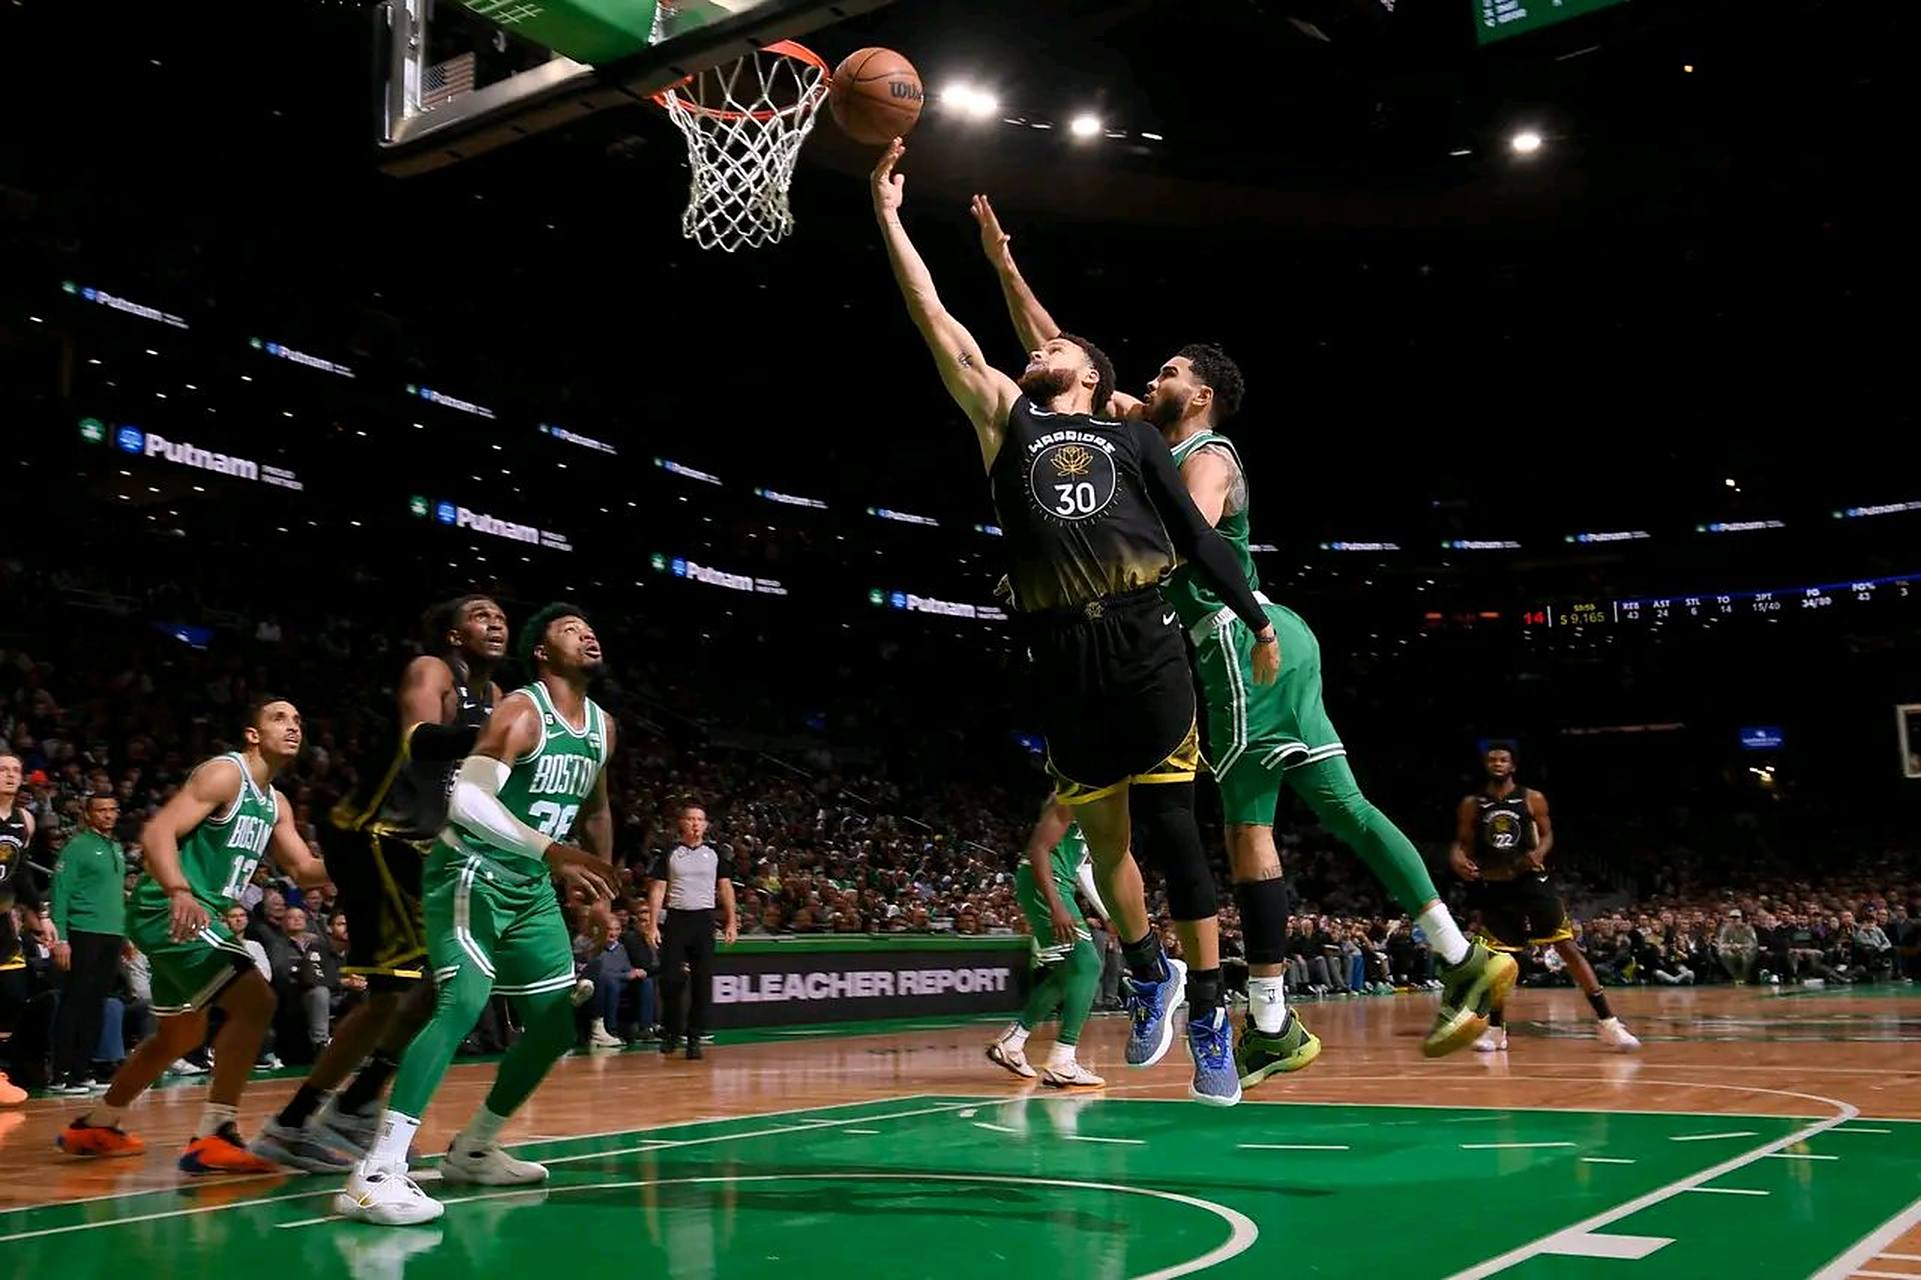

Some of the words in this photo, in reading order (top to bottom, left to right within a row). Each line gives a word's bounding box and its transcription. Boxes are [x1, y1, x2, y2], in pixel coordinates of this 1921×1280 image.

[144, 432, 259, 481] Putnam
[1028, 430, 1116, 454] WARRIORS
[1054, 482, 1097, 515] 30
[456, 506, 539, 545] Putnam
[1653, 600, 1670, 608] AST
[1717, 596, 1730, 604] TO
[1493, 833, 1513, 849] 22
[711, 972, 895, 1003] BLEACHER
[897, 968, 1010, 995] REPORT
